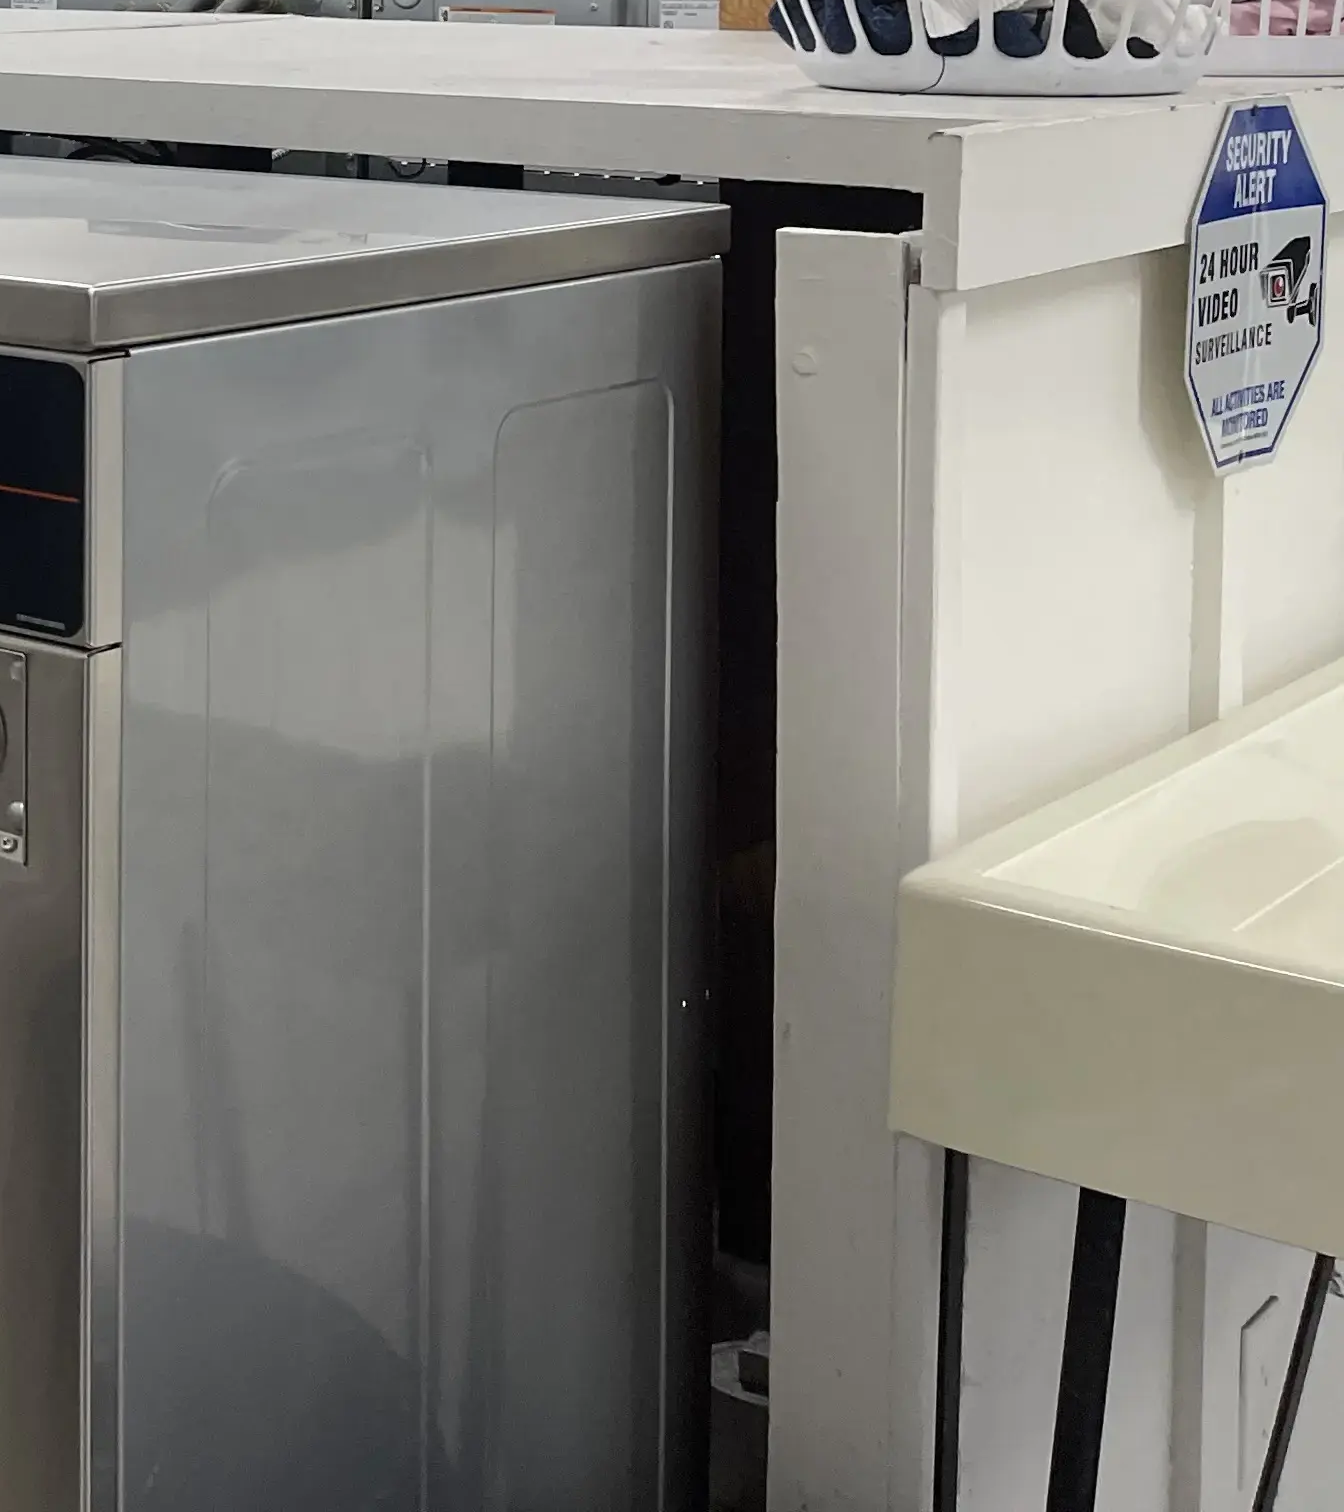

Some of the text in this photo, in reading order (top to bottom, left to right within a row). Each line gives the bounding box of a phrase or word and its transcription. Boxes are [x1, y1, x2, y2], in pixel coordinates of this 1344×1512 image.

[1226, 129, 1292, 172] SECURITY
[1234, 168, 1277, 208] ALERT
[1200, 242, 1258, 284] 24 HOUR
[1198, 288, 1238, 327] VIDEO
[1195, 323, 1272, 365] SURVEILLANCE
[1266, 379, 1286, 402] ARE
